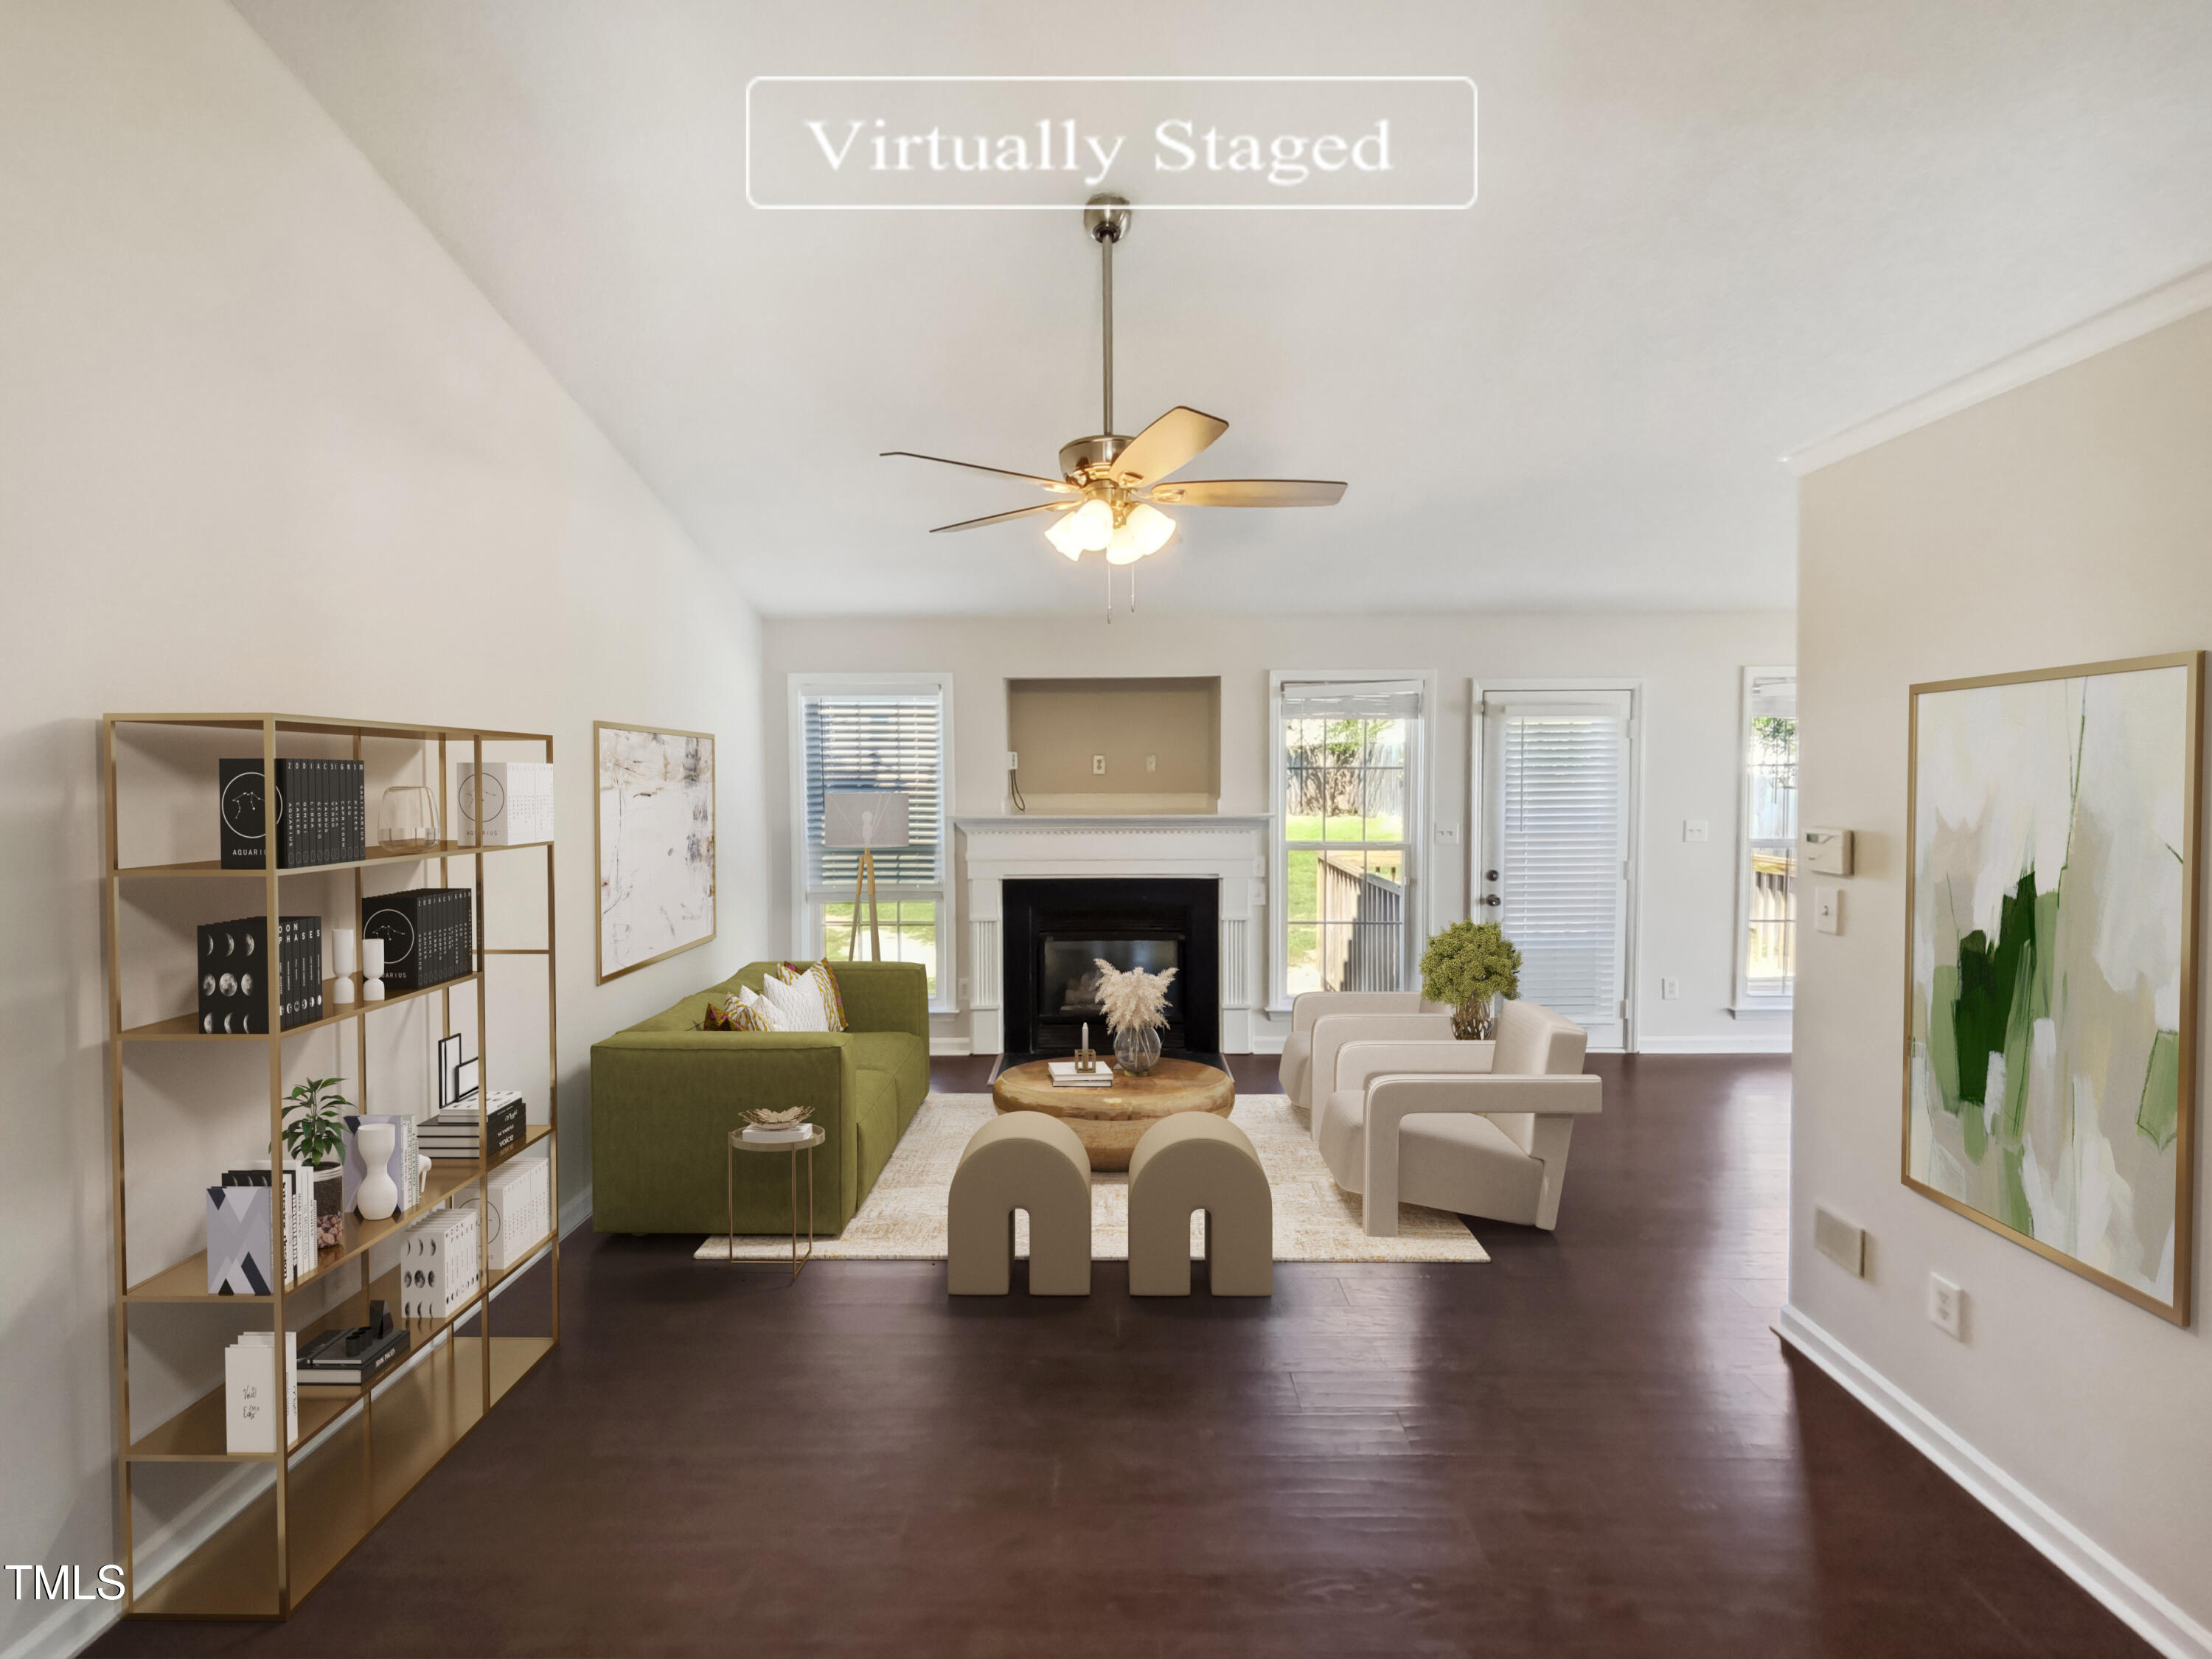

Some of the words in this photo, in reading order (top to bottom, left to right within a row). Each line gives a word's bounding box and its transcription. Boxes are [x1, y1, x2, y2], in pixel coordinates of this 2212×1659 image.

[288, 762, 327, 771] ZODIAC
[279, 922, 298, 933] OON
[498, 1134, 514, 1147] voice
